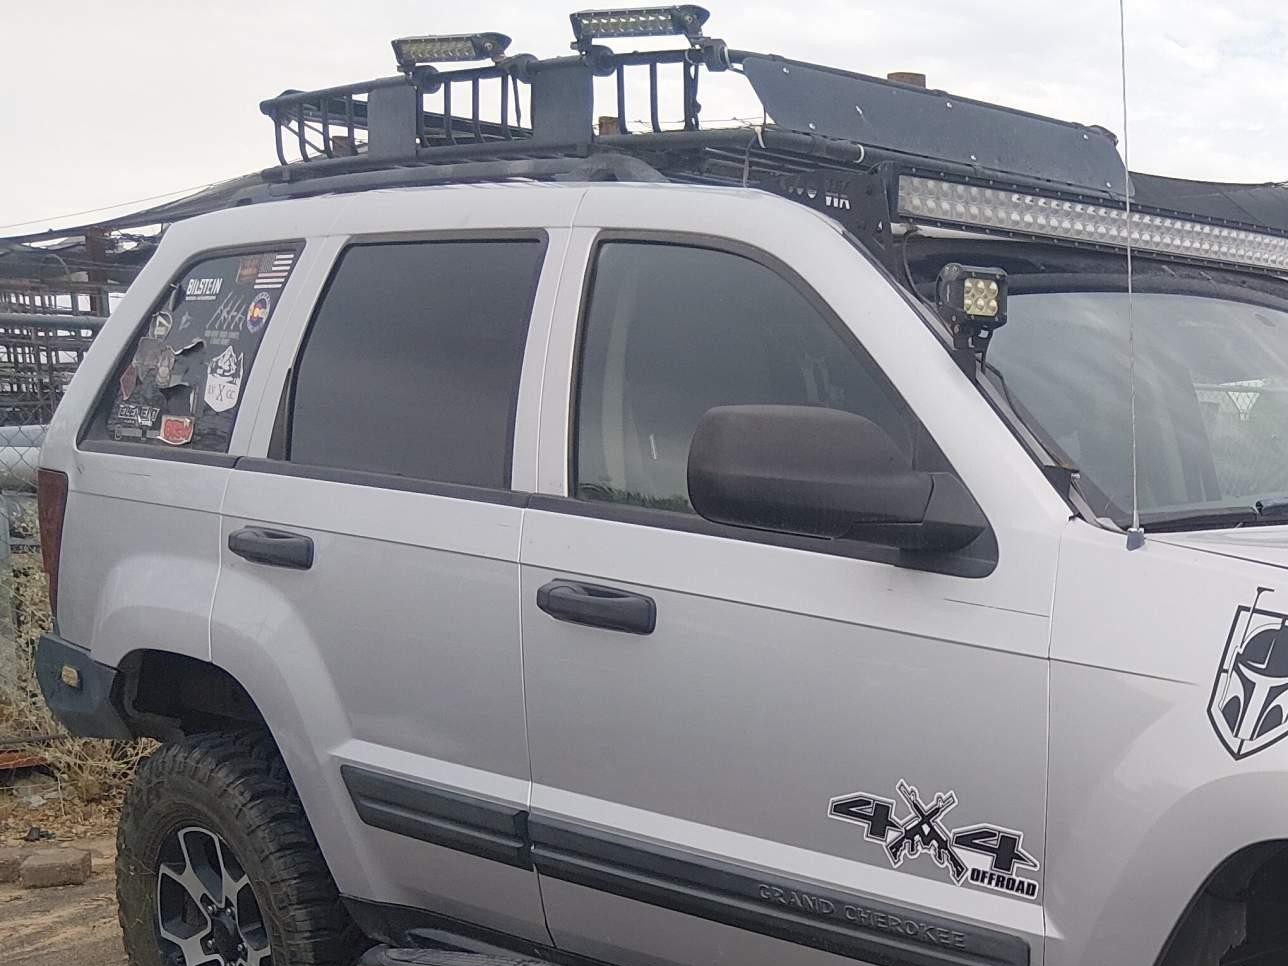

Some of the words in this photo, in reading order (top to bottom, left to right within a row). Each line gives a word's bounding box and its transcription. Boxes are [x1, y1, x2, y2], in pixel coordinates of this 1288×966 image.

[185, 277, 223, 296] BILSTEIN
[969, 868, 1038, 898] OFFROAD
[759, 883, 835, 916] GRAND
[843, 905, 967, 950] CHEROKEE
